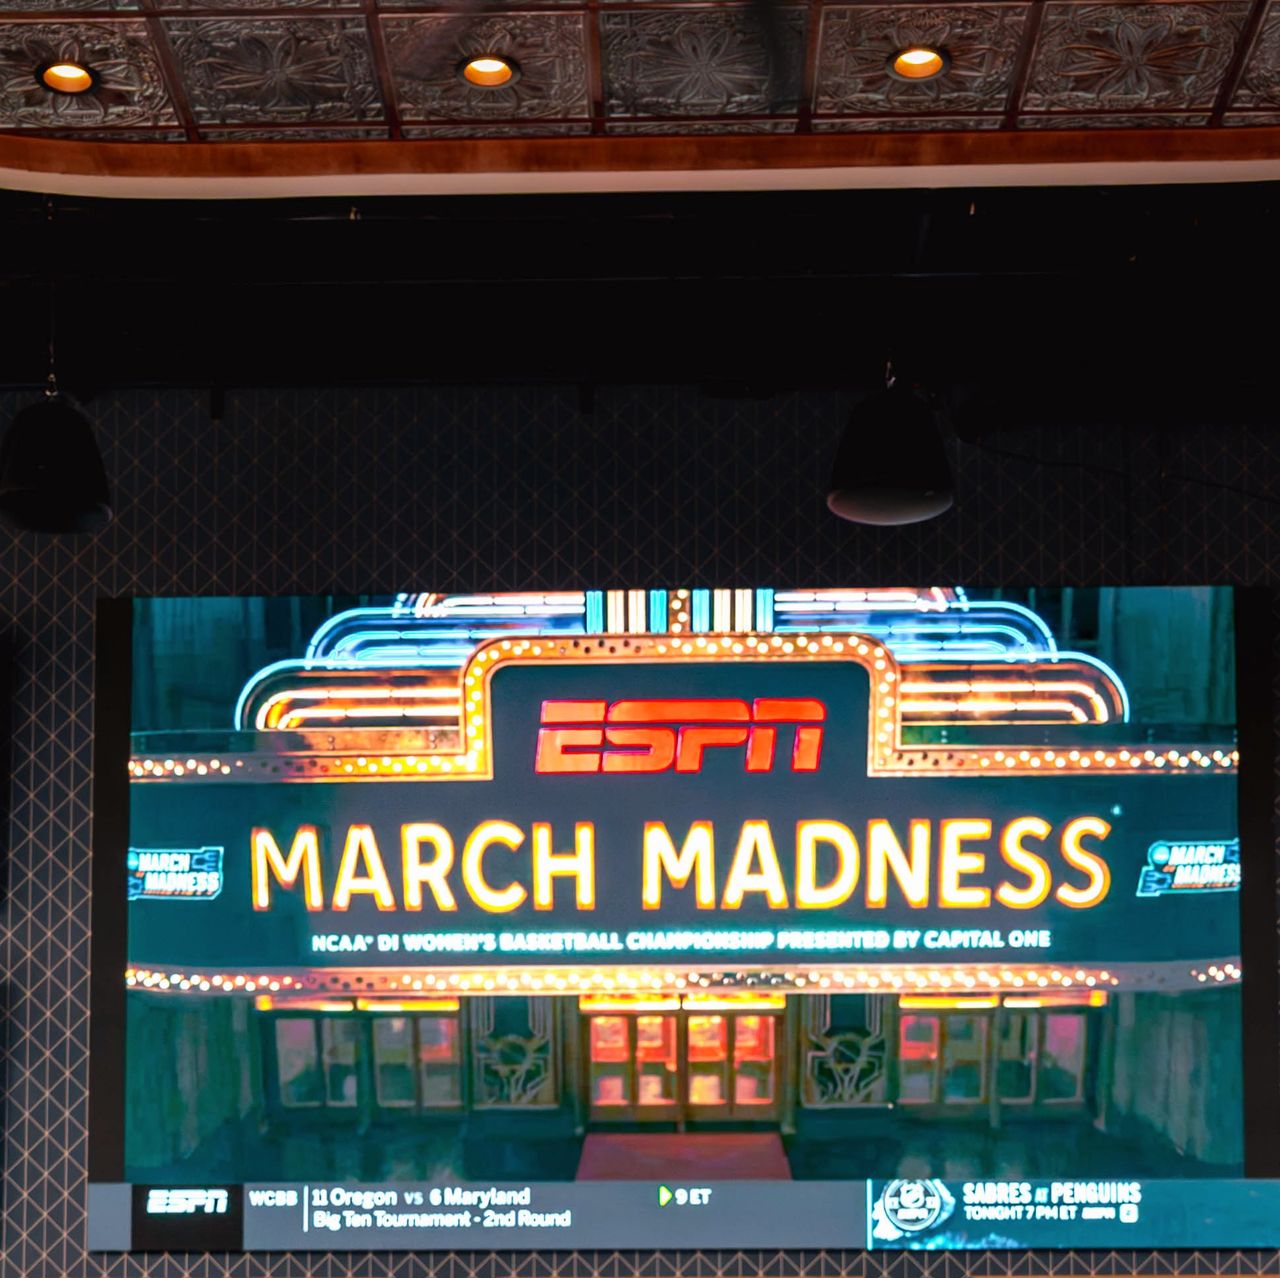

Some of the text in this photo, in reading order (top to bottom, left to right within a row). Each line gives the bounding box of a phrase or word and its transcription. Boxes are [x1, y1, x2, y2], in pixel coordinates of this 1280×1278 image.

[534, 698, 825, 774] ESPN
[138, 852, 190, 872] MARCH
[251, 816, 1112, 914] MARCH MADNESS
[1168, 845, 1226, 865] MARCH
[144, 871, 220, 892] MADNESS
[378, 935, 399, 951] DI
[403, 934, 496, 951] WOMEN'S
[500, 933, 622, 951] BASKETBALL
[626, 931, 775, 950] CHAMPIONSHIP
[777, 931, 890, 949] PRESENTED
[893, 931, 920, 948] BY
[924, 930, 1005, 948] CAPITAL
[1009, 930, 1051, 948] ONE
[147, 1189, 228, 1213] ESPN
[249, 1190, 298, 1206] WCBB
[312, 1187, 531, 1209] 11 Oregon vs 6 Maryland
[675, 1189, 712, 1205] 9 ET
[963, 1182, 1032, 1204] SABRES
[1050, 1182, 1142, 1204] PENGUINS
[313, 1210, 341, 1231] Big
[343, 1210, 372, 1227] Ten
[373, 1210, 471, 1228] Tournament
[483, 1210, 516, 1227] 2nd
[518, 1210, 571, 1227] Round
[964, 1206, 1024, 1220] TONIGHT
[1025, 1206, 1035, 1219] 7
[1035, 1206, 1059, 1219] PM
[1060, 1206, 1078, 1219] ET
